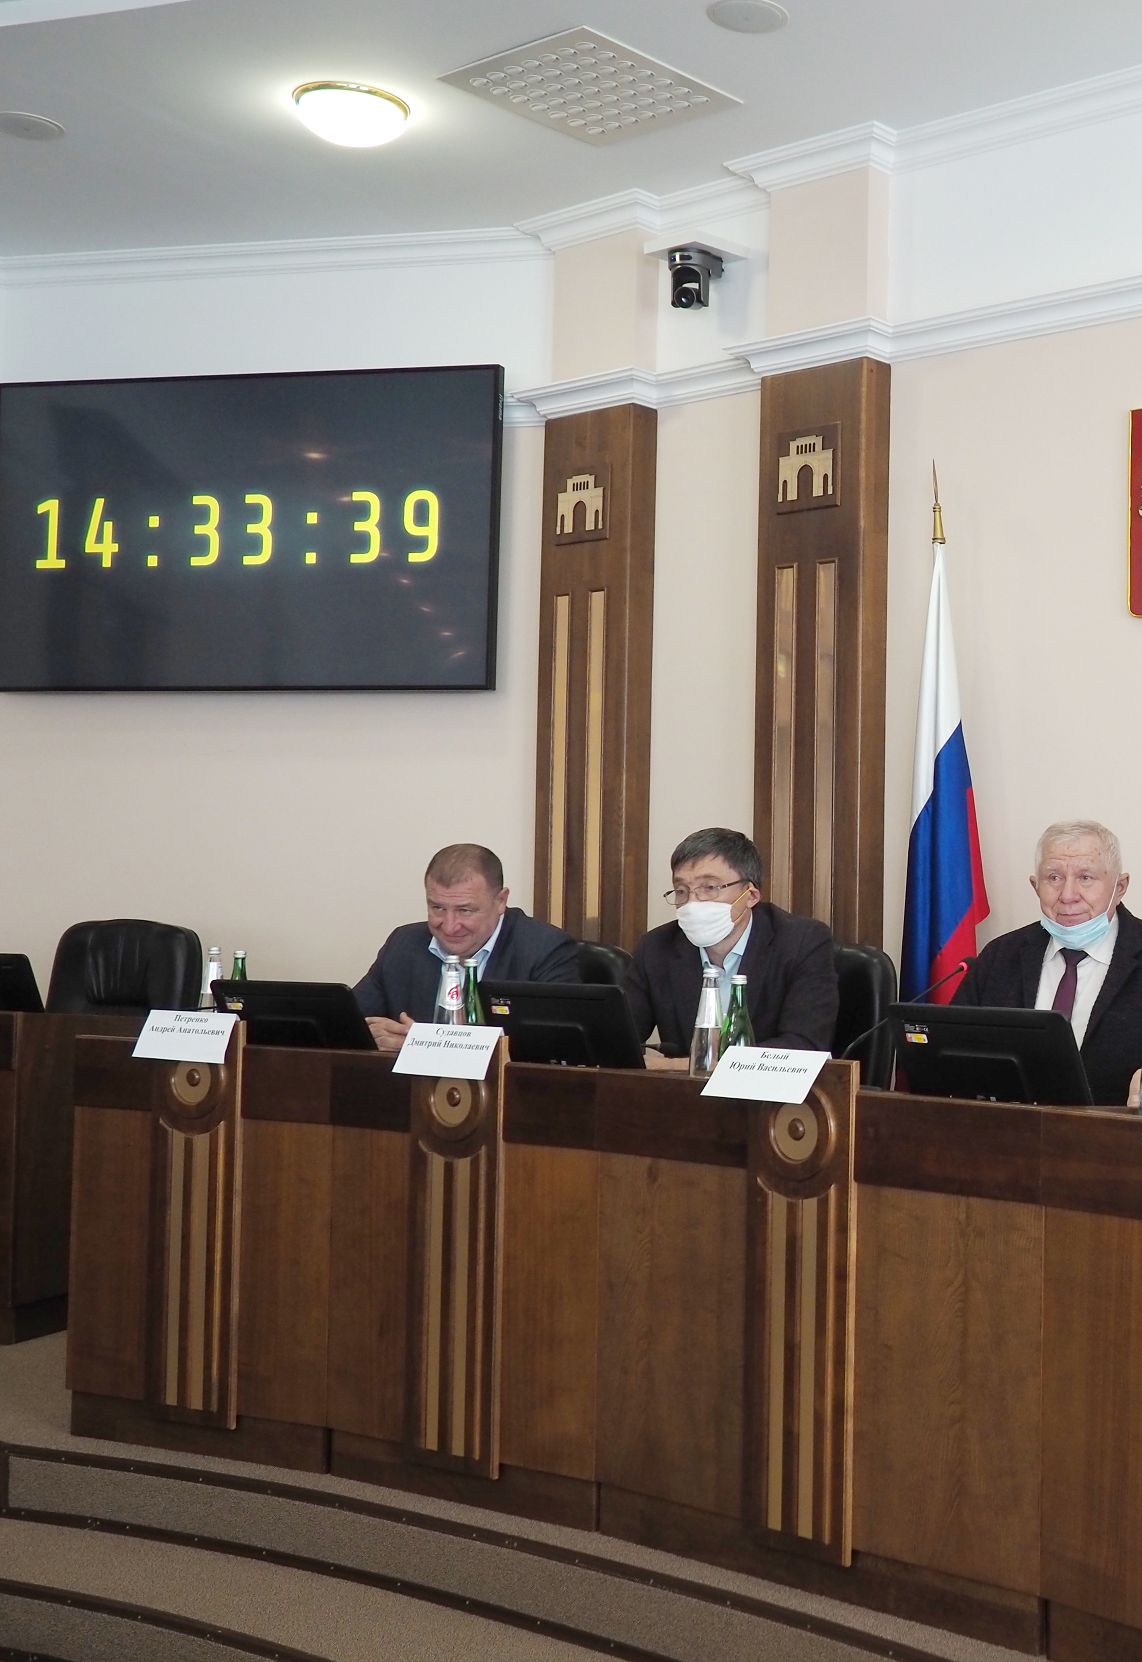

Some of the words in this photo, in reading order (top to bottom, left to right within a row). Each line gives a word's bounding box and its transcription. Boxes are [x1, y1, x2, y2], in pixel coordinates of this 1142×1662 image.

[35, 489, 440, 569] 14:33:39
[173, 1014, 209, 1024] Петренко
[149, 1025, 176, 1035] Андрей
[177, 1026, 225, 1036] Анатольевич
[407, 1037, 442, 1049] Дмитрий
[442, 1040, 490, 1051] Николаевич
[760, 1051, 790, 1060] Белый
[729, 1061, 756, 1072] Юрий
[757, 1063, 808, 1074] Васильевич
